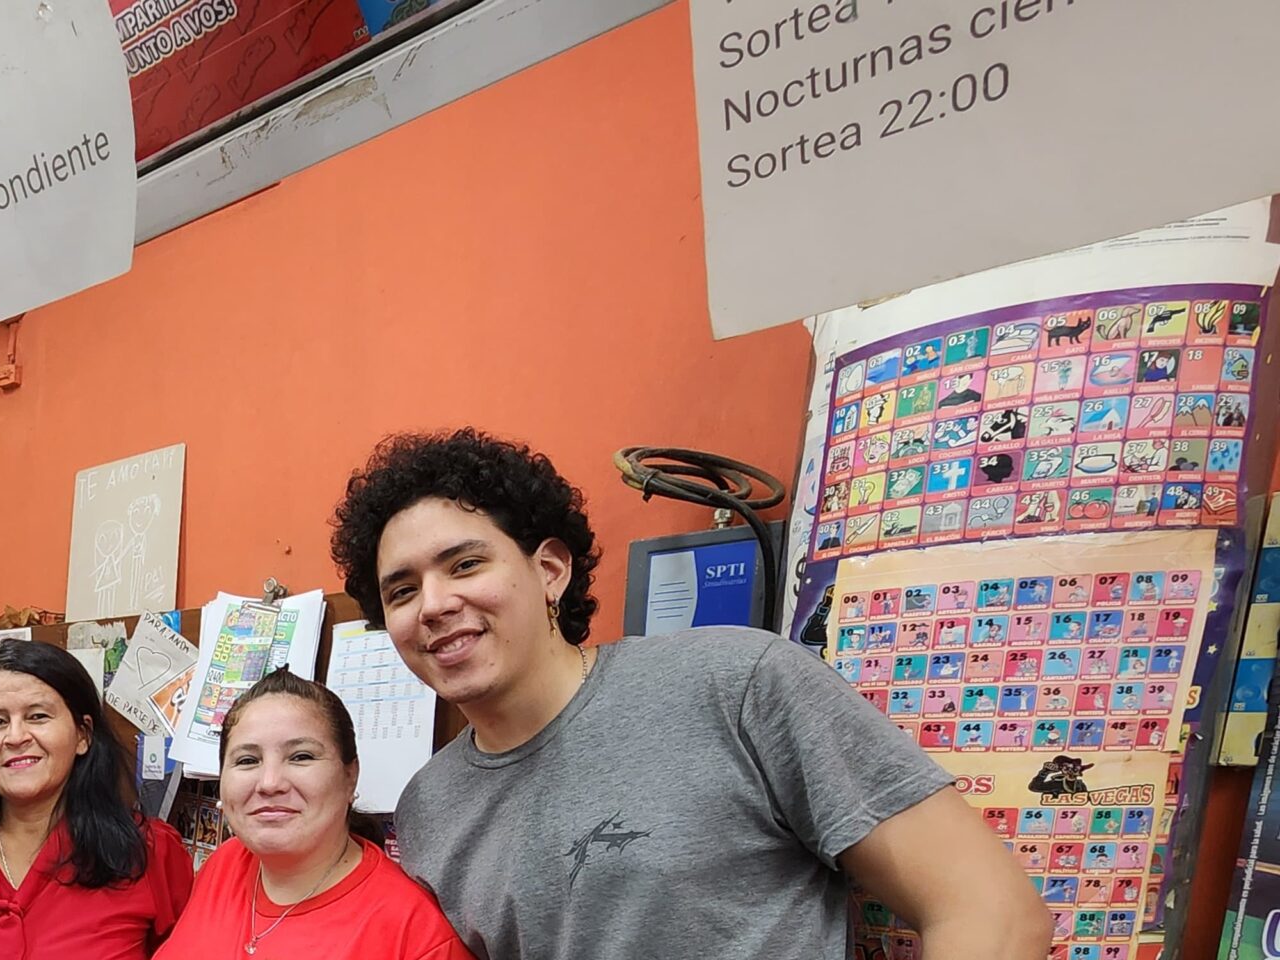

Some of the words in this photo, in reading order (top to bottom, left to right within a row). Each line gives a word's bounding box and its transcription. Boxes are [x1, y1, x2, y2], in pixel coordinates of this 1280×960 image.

[719, 0, 859, 68] Sortea
[723, 23, 953, 131] Nocturnas
[726, 118, 862, 188] Sortea
[878, 62, 1011, 139] 22:00
[948, 334, 966, 347] 03
[1046, 316, 1067, 328] 05
[1098, 309, 1117, 321] 06
[1232, 304, 1247, 315] 09
[900, 388, 916, 400] 12
[1093, 355, 1111, 367] 16
[1142, 351, 1159, 363] 17
[1187, 350, 1204, 361] 18
[1084, 400, 1103, 413] 26
[932, 462, 950, 475] 33
[978, 455, 999, 468] 34
[1173, 441, 1190, 452] 38
[79, 471, 98, 509] TE
[971, 498, 990, 510] 44
[1071, 490, 1091, 501] 46
[705, 562, 745, 579] SPTI
[843, 595, 859, 604] 00
[873, 592, 888, 601] 01
[905, 588, 923, 598] 02
[942, 585, 960, 594] 03
[1019, 579, 1038, 589] 05
[1059, 577, 1078, 587] 06
[1099, 576, 1118, 586] 07
[1136, 574, 1153, 584] 08
[1171, 573, 1189, 583] 09
[939, 620, 956, 630] 13
[977, 618, 995, 628] 14
[1015, 616, 1034, 626] 15
[1129, 612, 1146, 622] 18
[896, 657, 914, 667] 22
[932, 655, 951, 665] 23
[970, 653, 990, 663] 24
[1087, 650, 1106, 660] 27
[891, 691, 909, 700] 32
[1043, 687, 1062, 697] 36
[1148, 685, 1165, 695] 39
[1041, 792, 1089, 806] LAS
[1088, 784, 1155, 806] VEGAS
[1024, 810, 1043, 820] 56
[1095, 810, 1112, 820] 58
[1127, 810, 1144, 820] 59
[1056, 844, 1074, 854] 67
[1089, 845, 1106, 854] 68
[1122, 845, 1139, 854] 69
[1079, 913, 1097, 922] 88
[1074, 947, 1091, 956] 98
